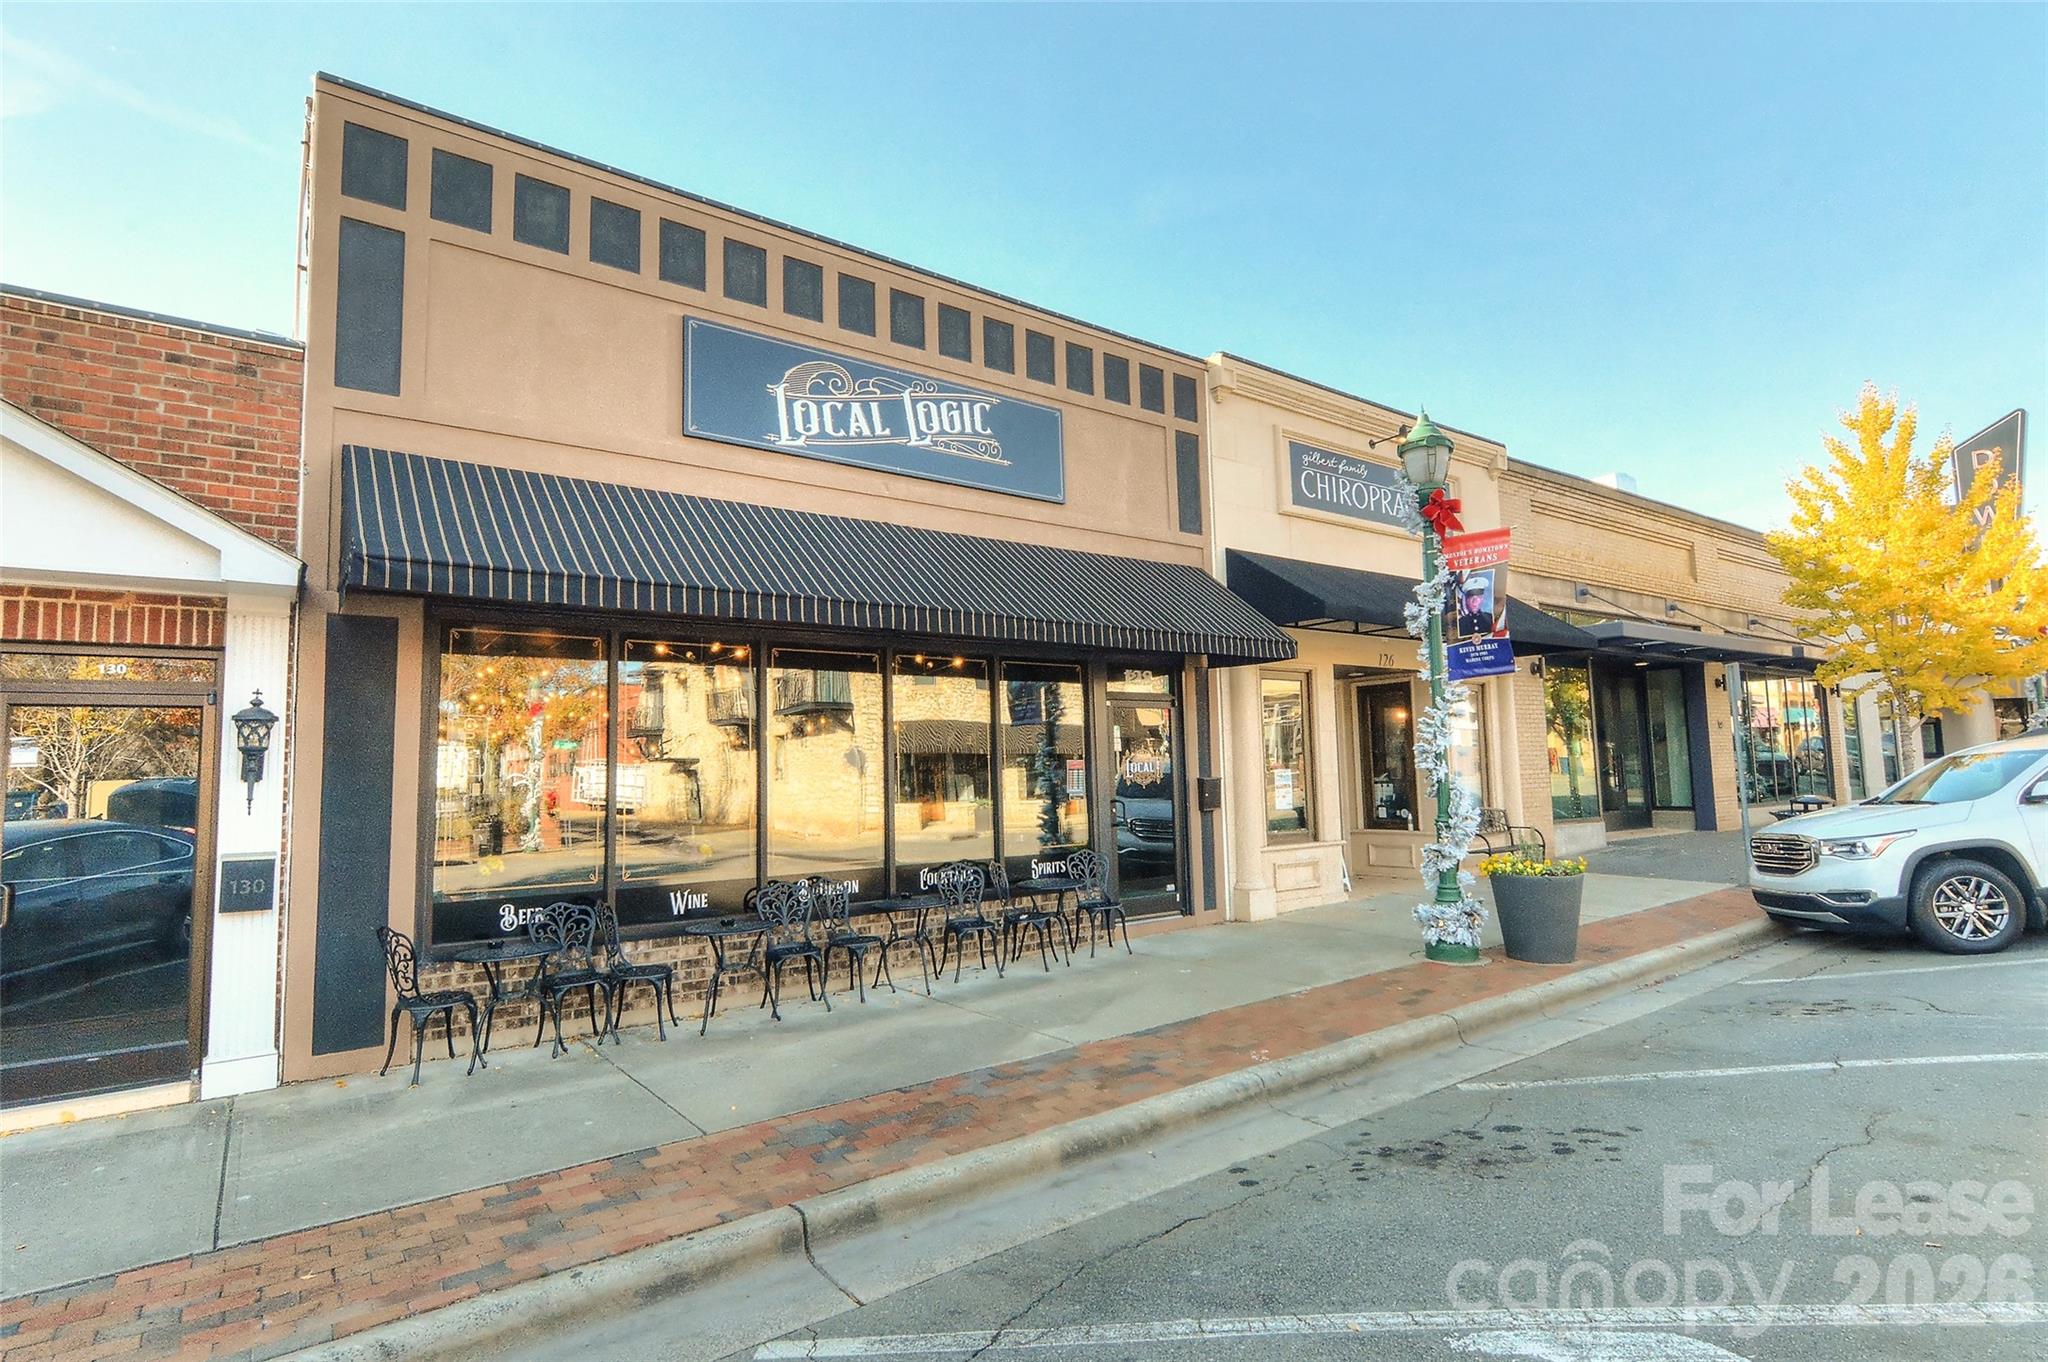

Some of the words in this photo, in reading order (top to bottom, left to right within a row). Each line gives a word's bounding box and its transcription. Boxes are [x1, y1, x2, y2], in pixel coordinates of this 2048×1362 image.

[1302, 451, 1337, 468] gilbert
[1338, 460, 1368, 479] family
[1301, 470, 1405, 516] CHIROPRA
[1453, 553, 1498, 567] VETERANS
[1378, 653, 1394, 666] 126
[98, 663, 127, 675] 130
[230, 879, 265, 894] 130
